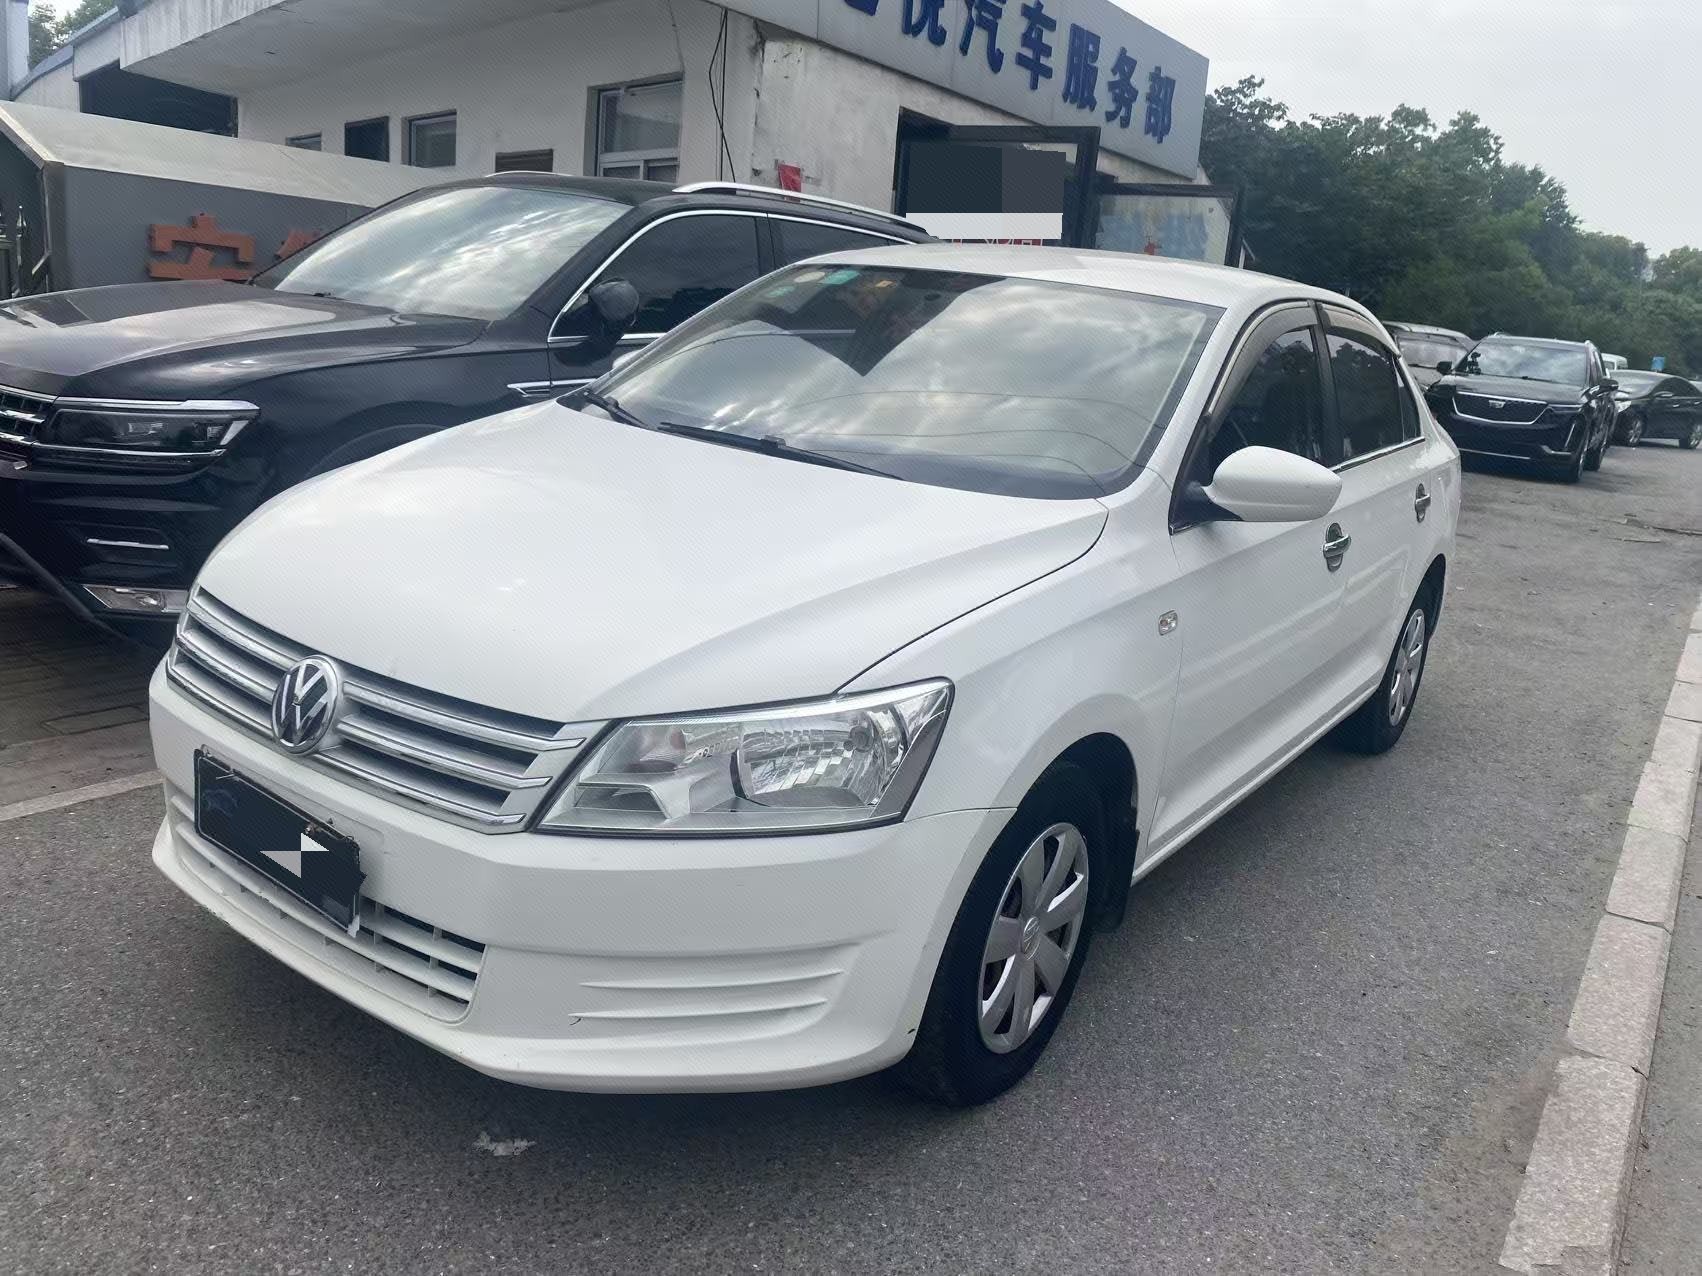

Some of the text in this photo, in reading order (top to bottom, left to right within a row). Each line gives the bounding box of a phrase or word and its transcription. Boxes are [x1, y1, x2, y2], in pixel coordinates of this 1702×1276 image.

[845, 0, 1176, 143] 汽车服务部
